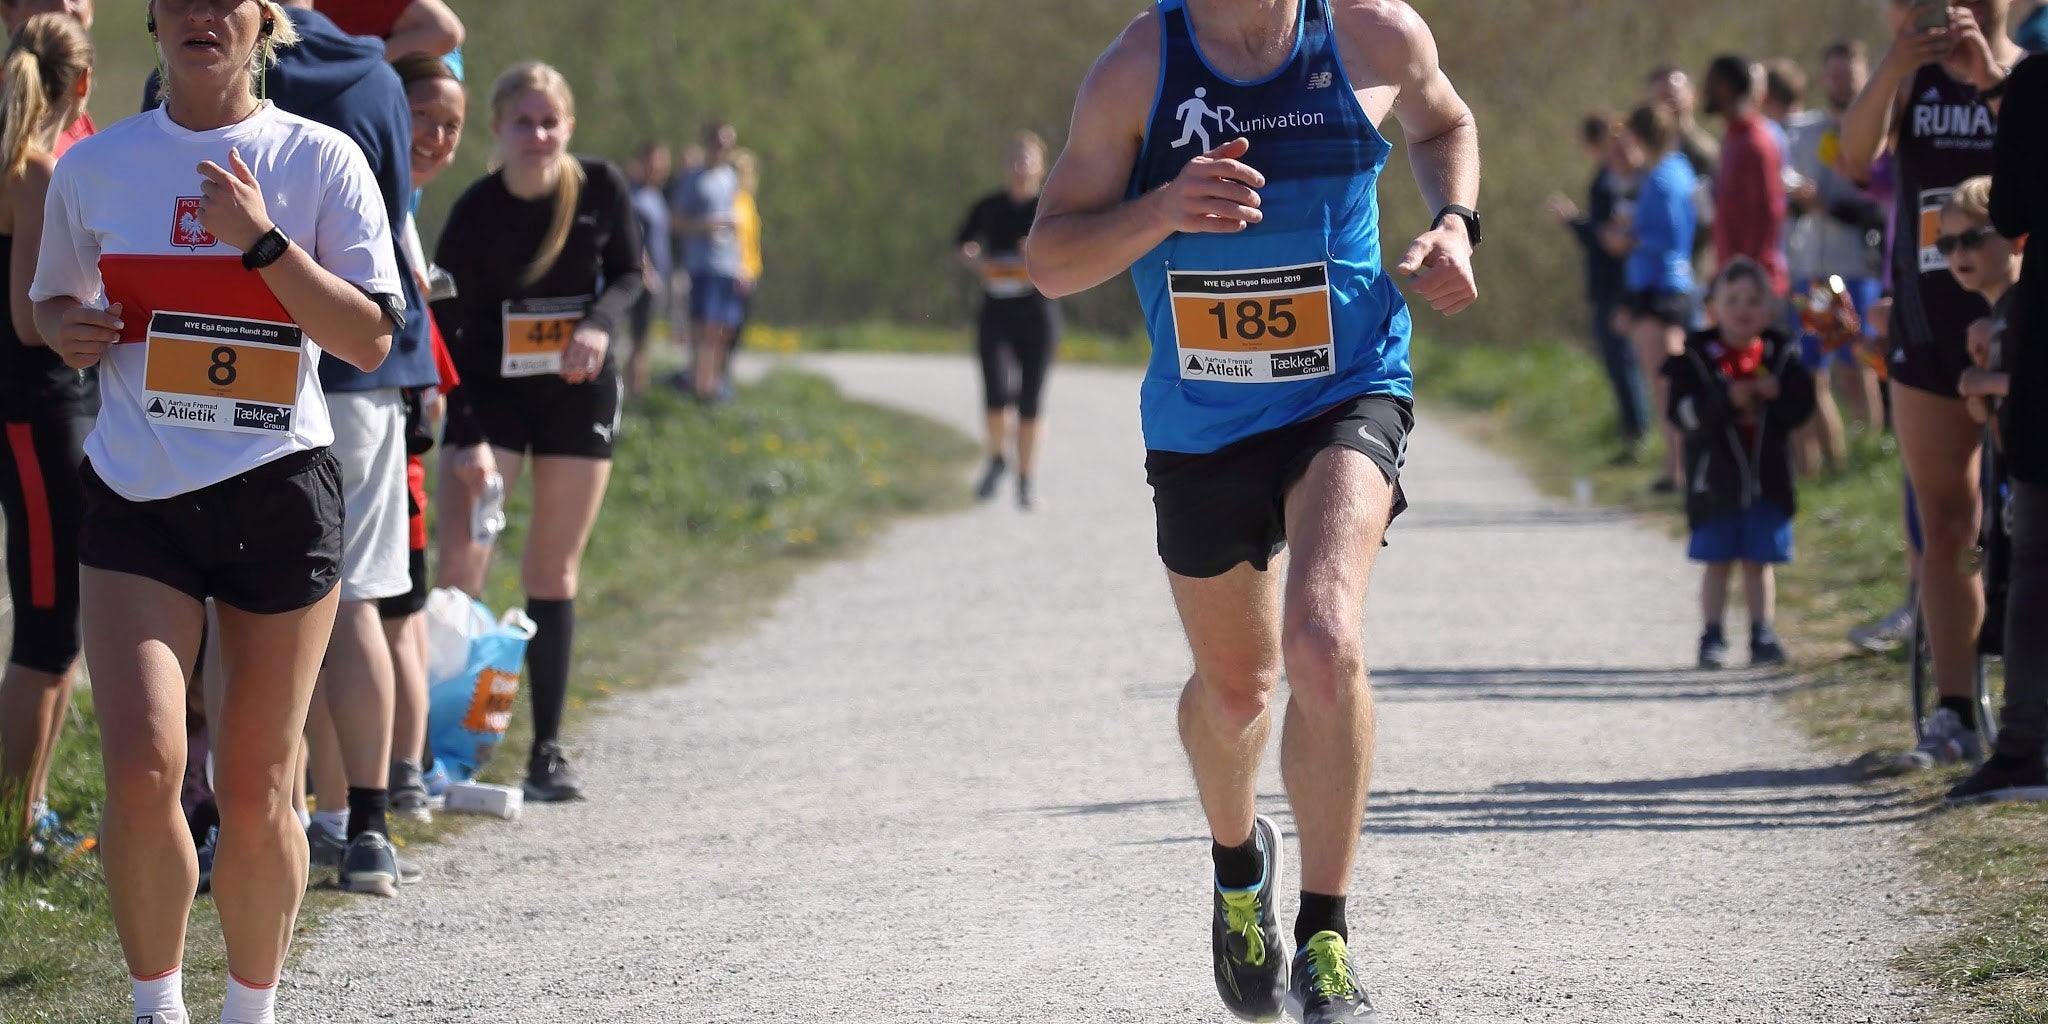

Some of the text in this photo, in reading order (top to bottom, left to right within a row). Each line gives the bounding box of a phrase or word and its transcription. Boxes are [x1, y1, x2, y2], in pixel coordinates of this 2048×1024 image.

[1216, 105, 1324, 133] Runivation
[1203, 280, 1219, 288] NYE
[1260, 277, 1283, 285] Rundt
[1283, 274, 1301, 283] 2019
[1208, 297, 1297, 340] 185
[184, 321, 200, 329] NYE
[239, 326, 260, 335] Rundt
[261, 329, 278, 337] 2019
[207, 346, 237, 386] 8
[1206, 362, 1253, 377] Atletik
[1270, 354, 1318, 370] Tækker
[1302, 365, 1326, 375] Group
[168, 399, 218, 410] Aarhus Fremad
[167, 405, 216, 423] Atletik
[235, 406, 280, 423] Tækker
[263, 421, 286, 431] Group
